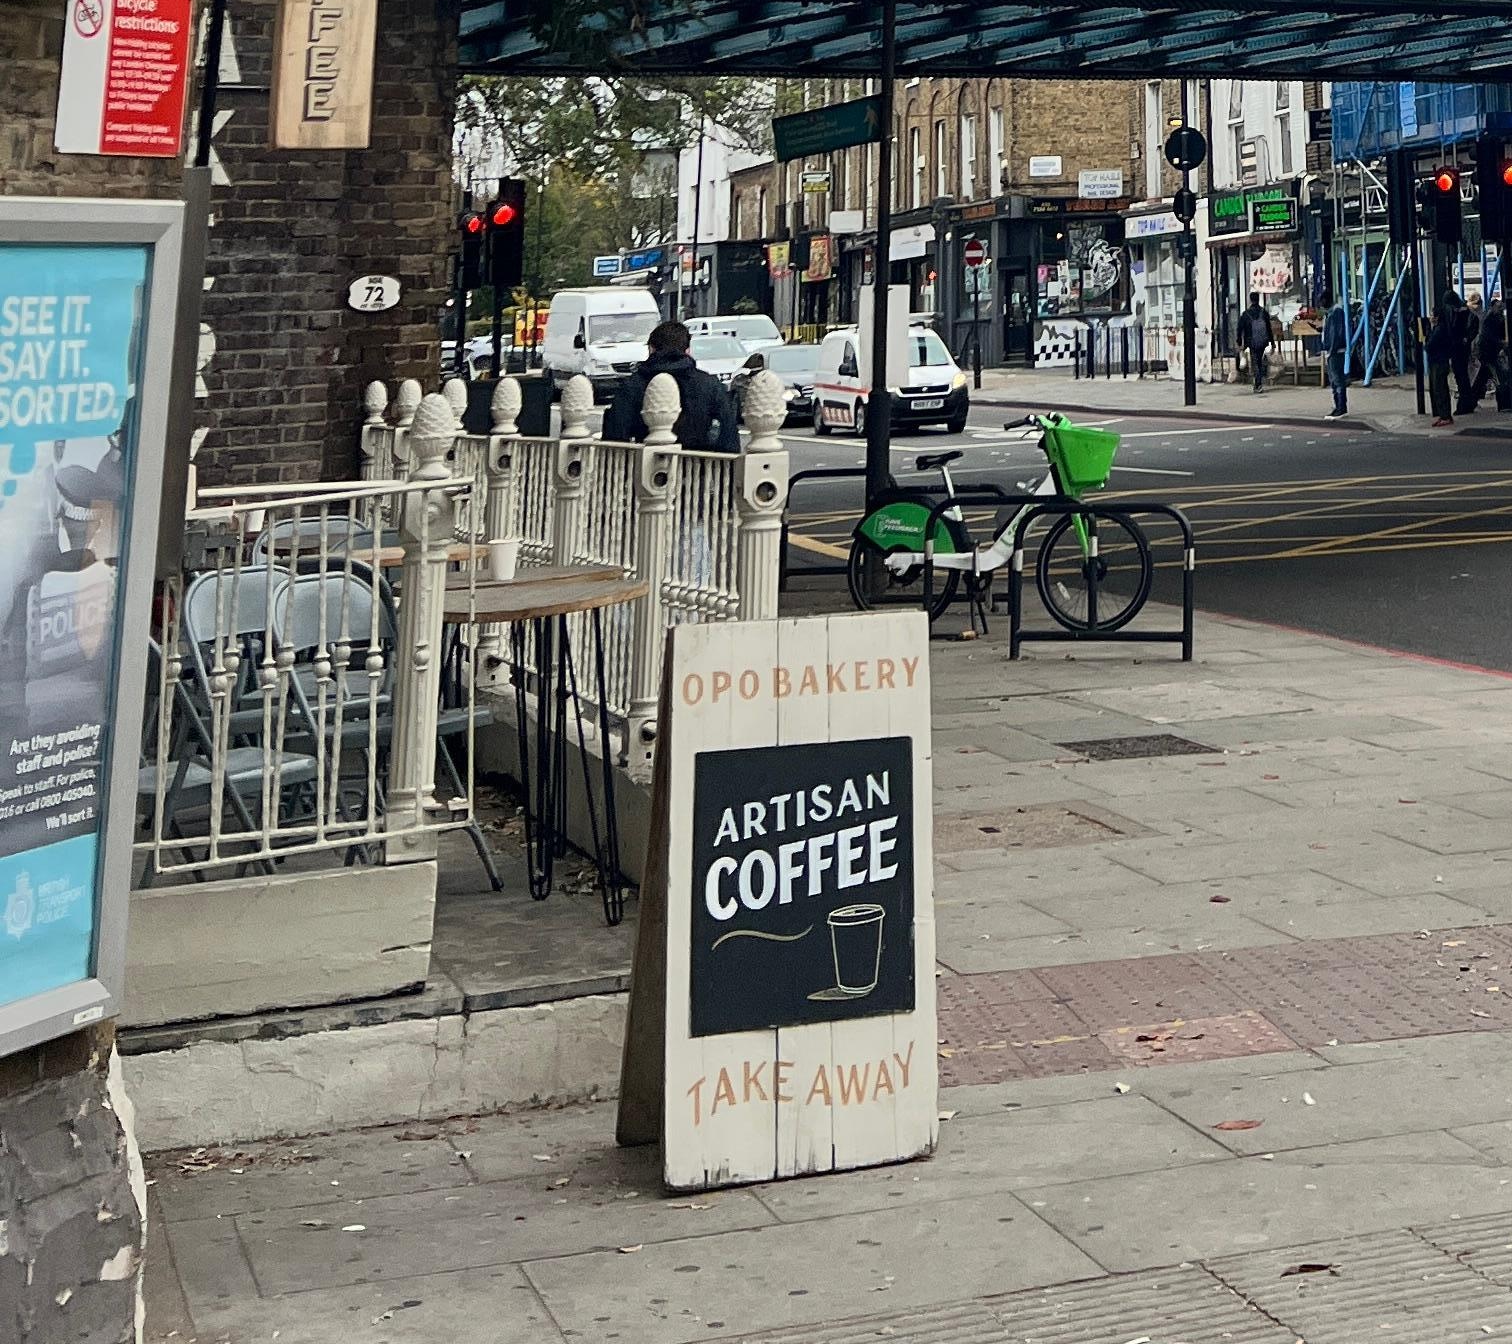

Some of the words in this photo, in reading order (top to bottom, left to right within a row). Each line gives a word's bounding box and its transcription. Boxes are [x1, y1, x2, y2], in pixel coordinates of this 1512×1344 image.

[114, 15, 180, 34] restrictions
[365, 286, 384, 303] 72
[1, 295, 58, 337] SEE
[61, 295, 92, 334] IT.
[0, 340, 56, 383] SAY
[58, 339, 90, 379] IT.
[0, 382, 120, 428] SORTED.
[682, 669, 760, 706] OPO
[773, 656, 920, 699] BAKERY
[9, 739, 30, 756] Are
[31, 734, 56, 751] they
[56, 723, 100, 745] avoiding
[16, 754, 42, 774] staff
[42, 749, 63, 768] and
[63, 740, 99, 767] police?
[15, 805, 25, 815] or
[25, 798, 40, 813] call
[40, 792, 62, 809] 0800
[23, 784, 34, 795] to
[56, 774, 69, 786] For
[45, 813, 68, 830] We'll
[67, 809, 86, 825] sort
[712, 770, 891, 847] ARTISAN
[705, 814, 899, 921] COFFEE
[687, 1059, 796, 1127] TAKE
[805, 1040, 915, 1107] AWAY
